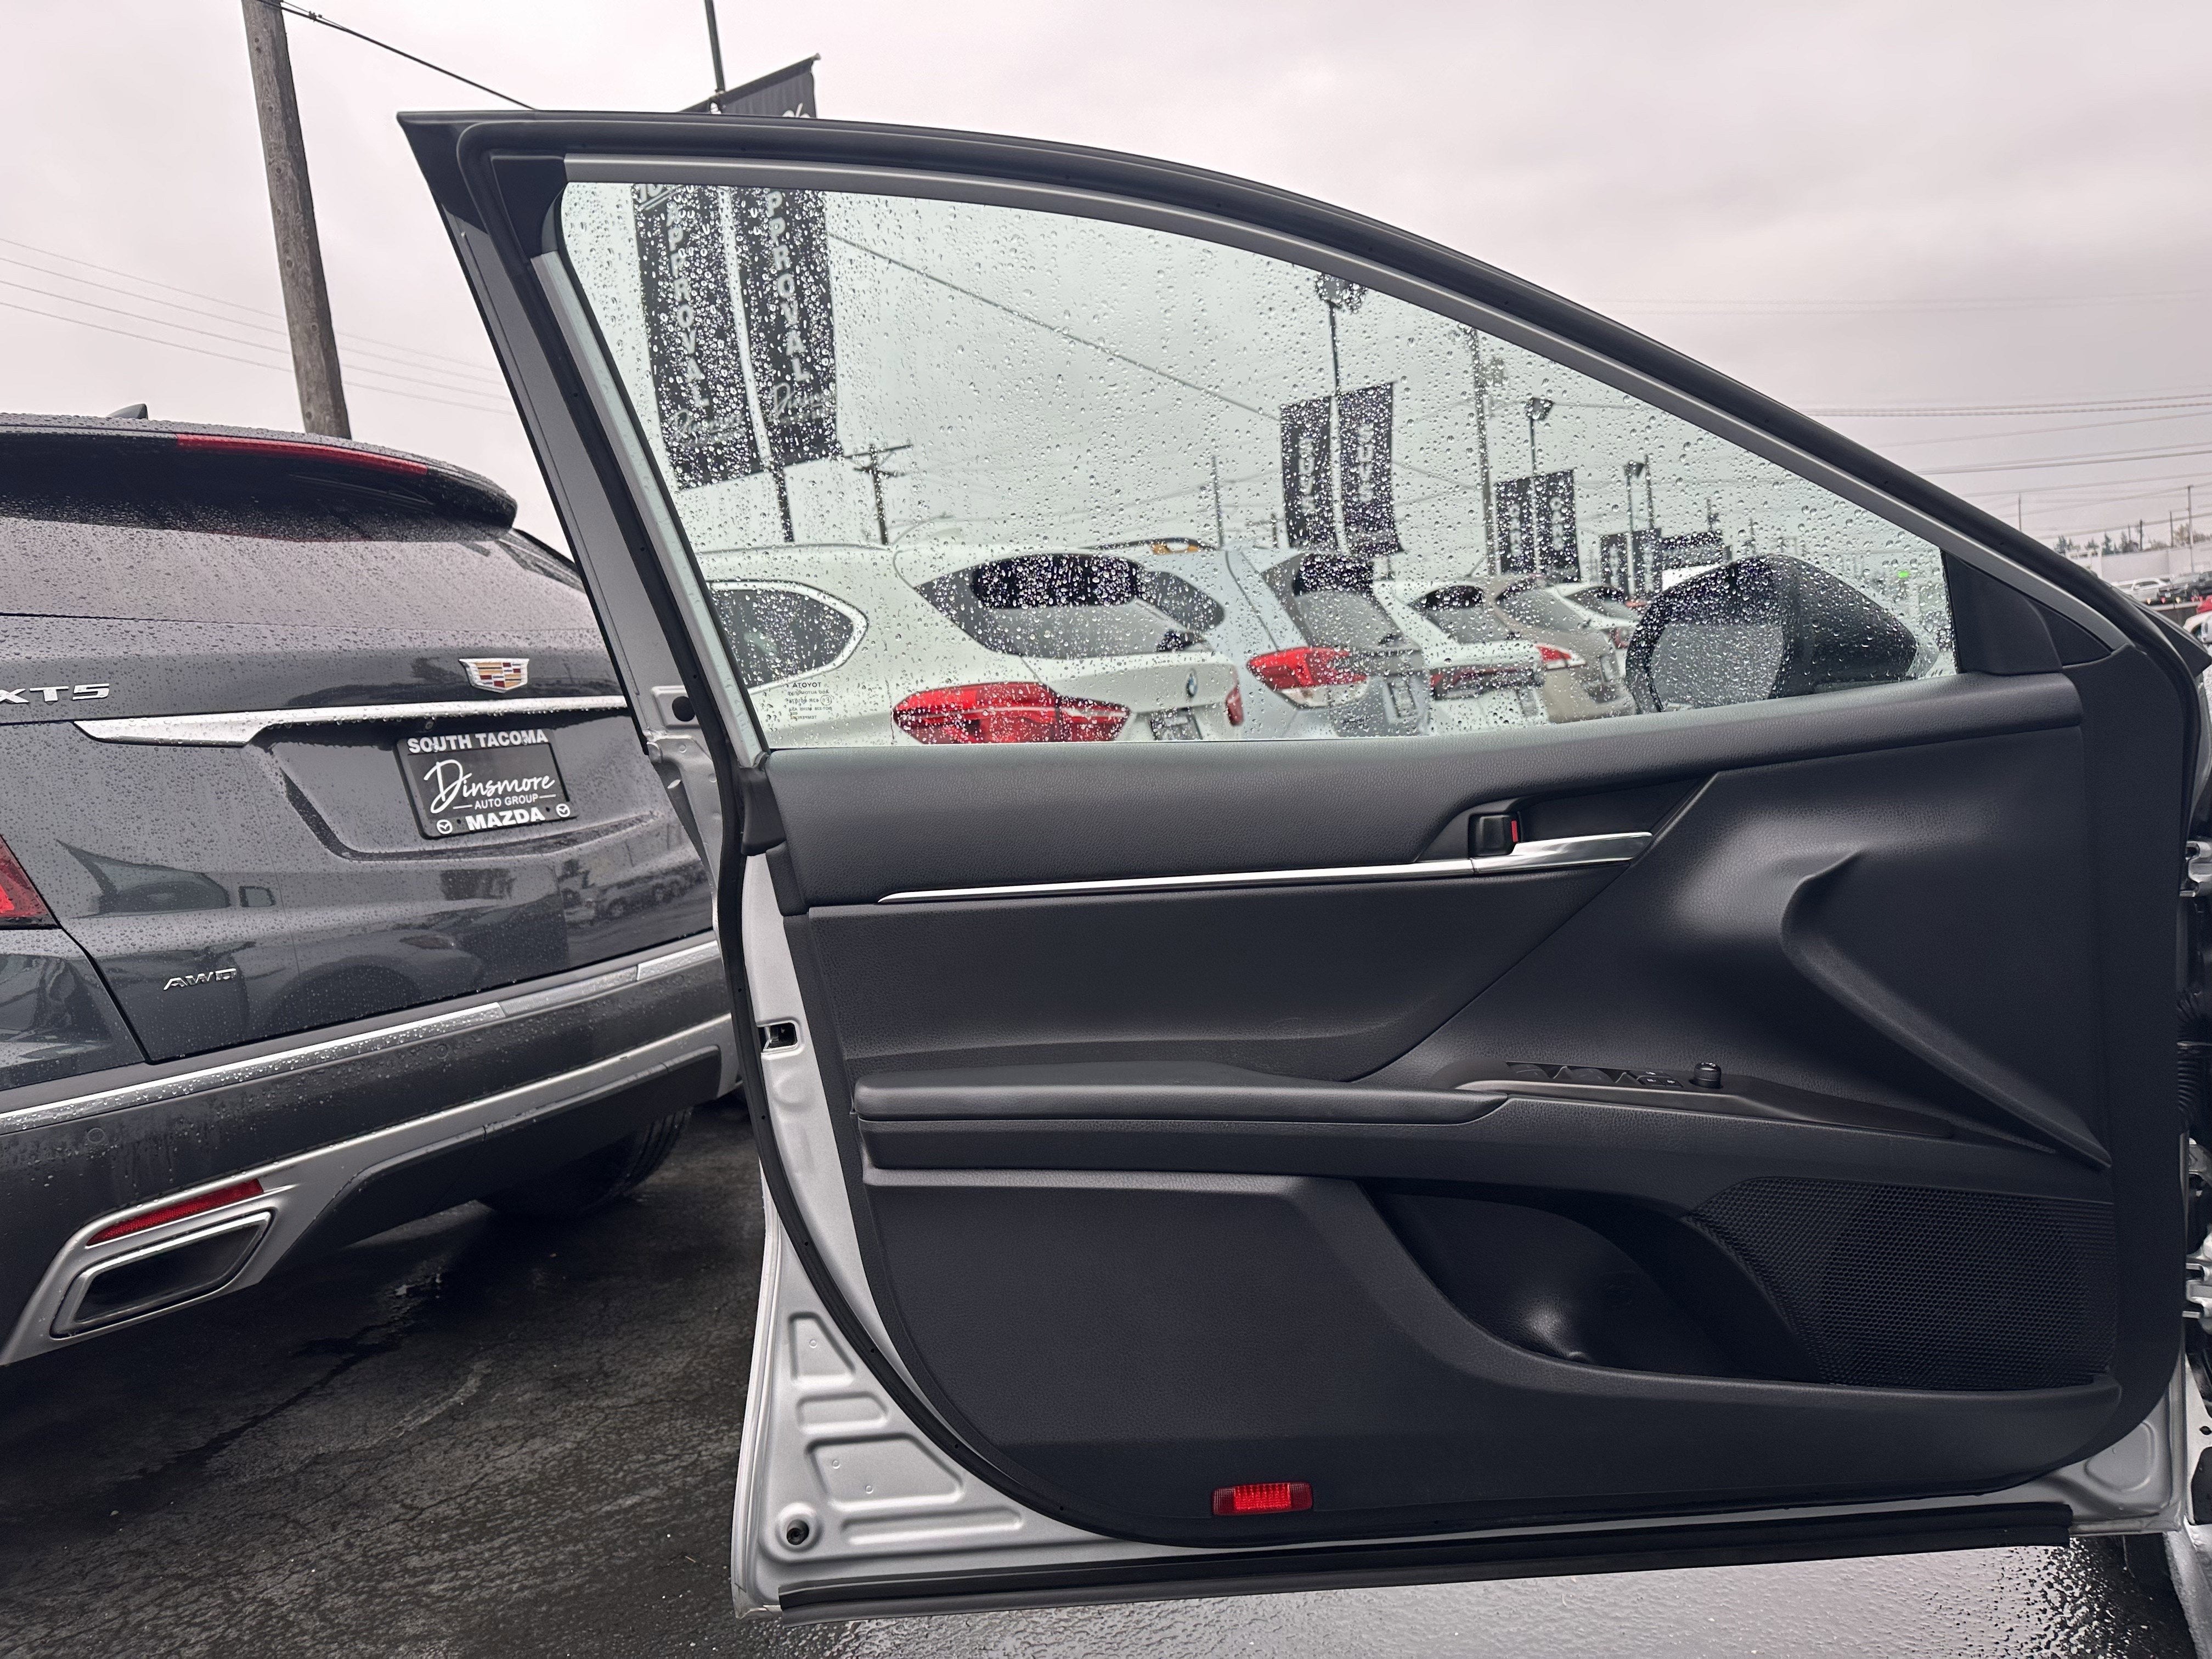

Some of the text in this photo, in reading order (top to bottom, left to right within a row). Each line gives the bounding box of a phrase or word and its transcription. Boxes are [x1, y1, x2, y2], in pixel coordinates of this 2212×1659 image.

[768, 190, 810, 382] PPROVAL
[0, 683, 110, 704] XT5
[407, 729, 548, 753] SOUTH TACOMA
[424, 759, 555, 814] Dinsmore
[474, 794, 539, 810] AUTO GROUP
[465, 807, 546, 831] MAZDA
[163, 968, 236, 991] AWD
